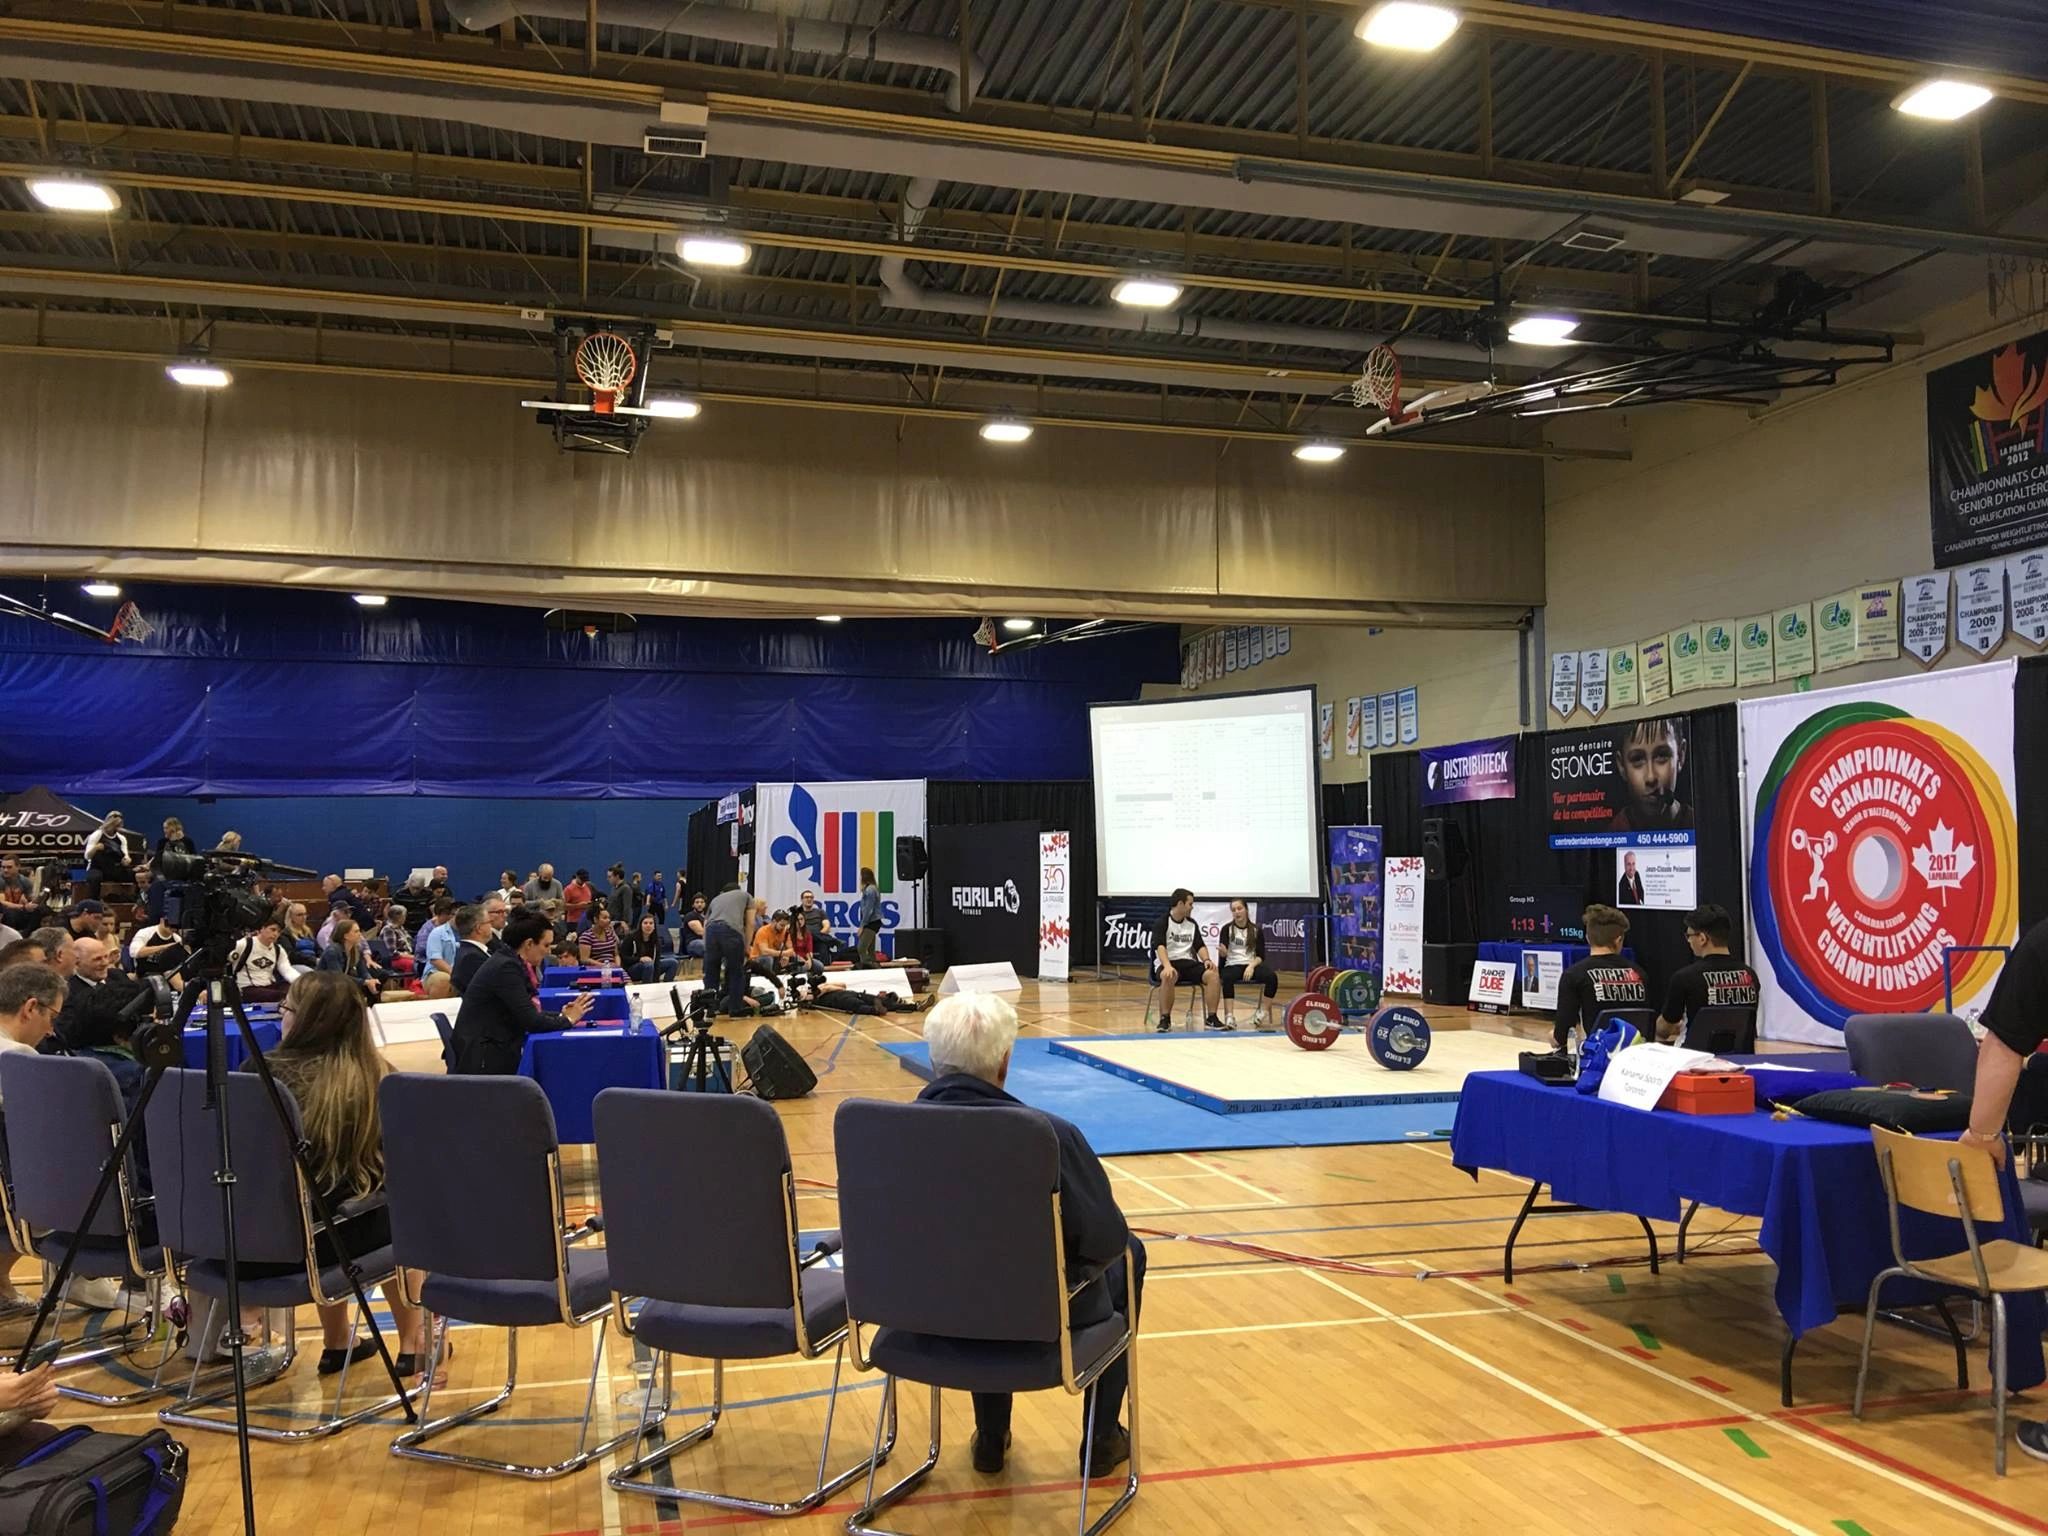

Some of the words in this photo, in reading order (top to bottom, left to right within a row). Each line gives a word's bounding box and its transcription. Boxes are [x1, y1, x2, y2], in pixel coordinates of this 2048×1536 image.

[2007, 450, 2029, 466] 2012
[1950, 470, 2029, 502] CHAMPIONNATS
[1959, 496, 1993, 515] SENIOR
[1969, 504, 2026, 526] QUALIFICATION
[1970, 616, 1996, 629] 2009
[1908, 627, 1924, 638] 2009
[1551, 744, 1575, 754] centre
[1578, 739, 1613, 752] dentaire
[1443, 751, 1508, 780] DISTRIBUTECK
[1810, 745, 1942, 809] CHAMPIONNATS
[1831, 777, 1922, 819] CANADIENS
[1637, 834, 1651, 844] 450
[1652, 832, 1689, 844] 444-5900
[1929, 854, 1957, 871] 2017
[952, 886, 1004, 911] GORILA
[1509, 896, 1526, 904] Group
[1511, 917, 1535, 931] 1:13
[1826, 900, 1939, 959] WEIGHTLIFTING
[1560, 927, 1584, 939] 115kg
[1817, 928, 1957, 991] CHAMPIONSHIPS
[1305, 1000, 1330, 1010] ELEIKO
[1392, 1012, 1420, 1027] ELEIKO
[1384, 1050, 1412, 1065] ELEIKO
